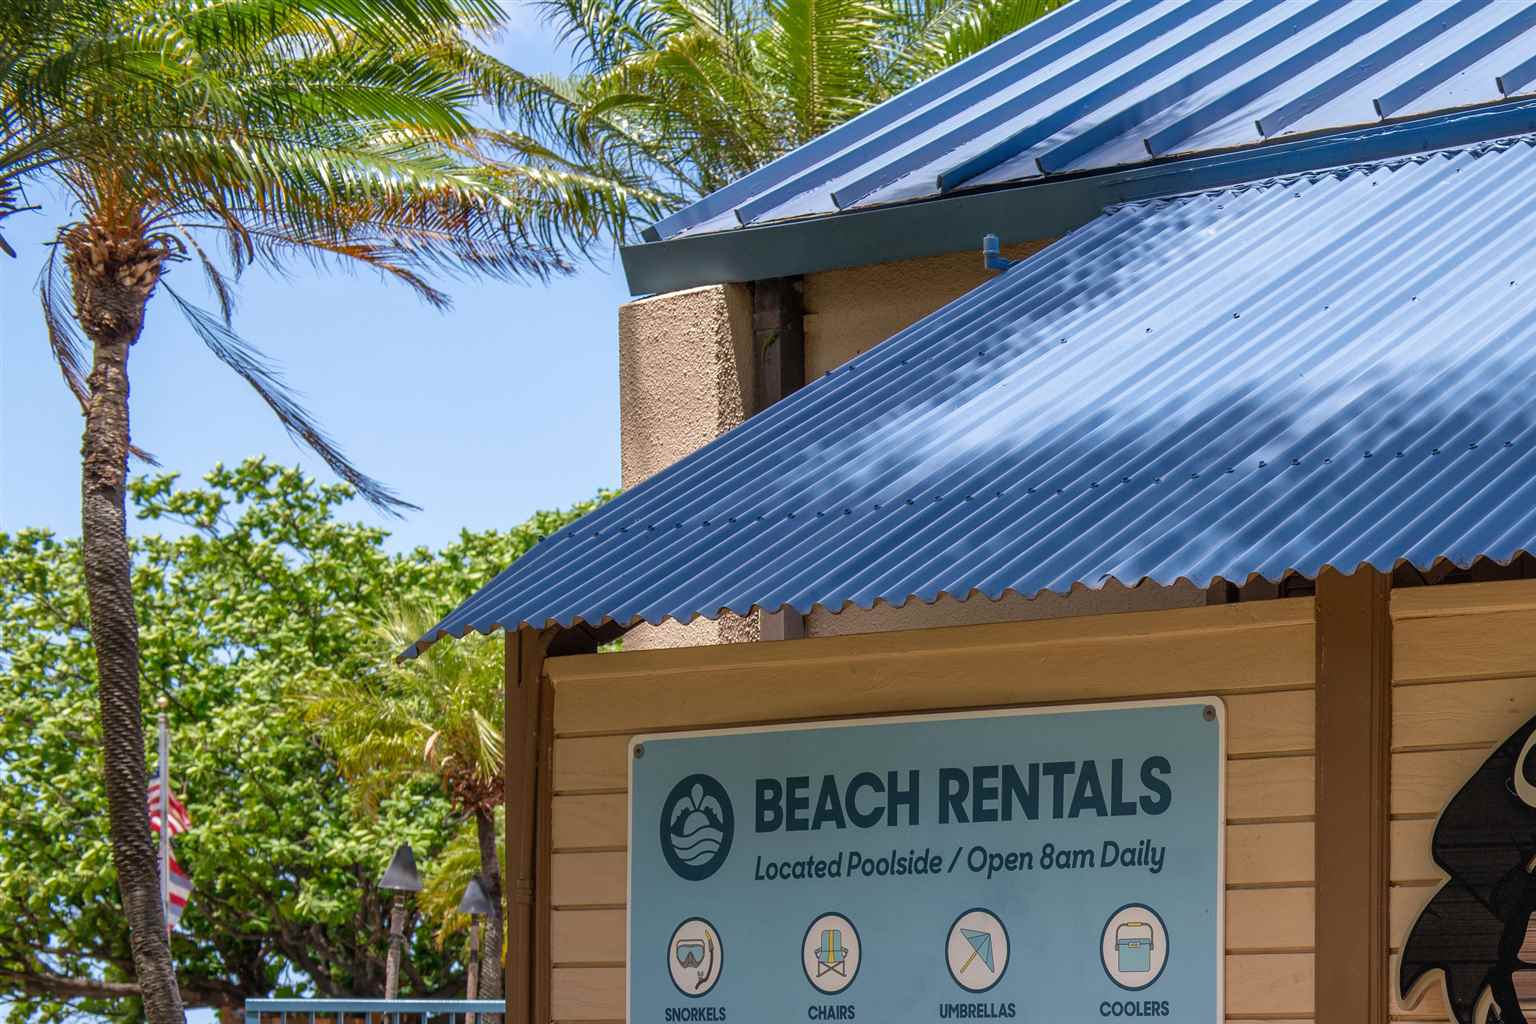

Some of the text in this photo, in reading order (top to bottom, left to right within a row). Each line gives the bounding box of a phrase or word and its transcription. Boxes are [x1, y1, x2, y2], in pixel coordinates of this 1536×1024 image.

[755, 756, 1171, 833] BEACH RENTALS
[755, 852, 843, 880] Located
[847, 848, 942, 877] Poolside
[968, 846, 1033, 879] Open
[1040, 843, 1095, 870] 8am
[1101, 839, 1165, 873] Daily
[665, 1007, 726, 1021] SNORKELS
[808, 1005, 855, 1020] CHAIRS
[940, 1003, 1016, 1018] UMBRELLAS
[1100, 1001, 1169, 1016] COOLERS
